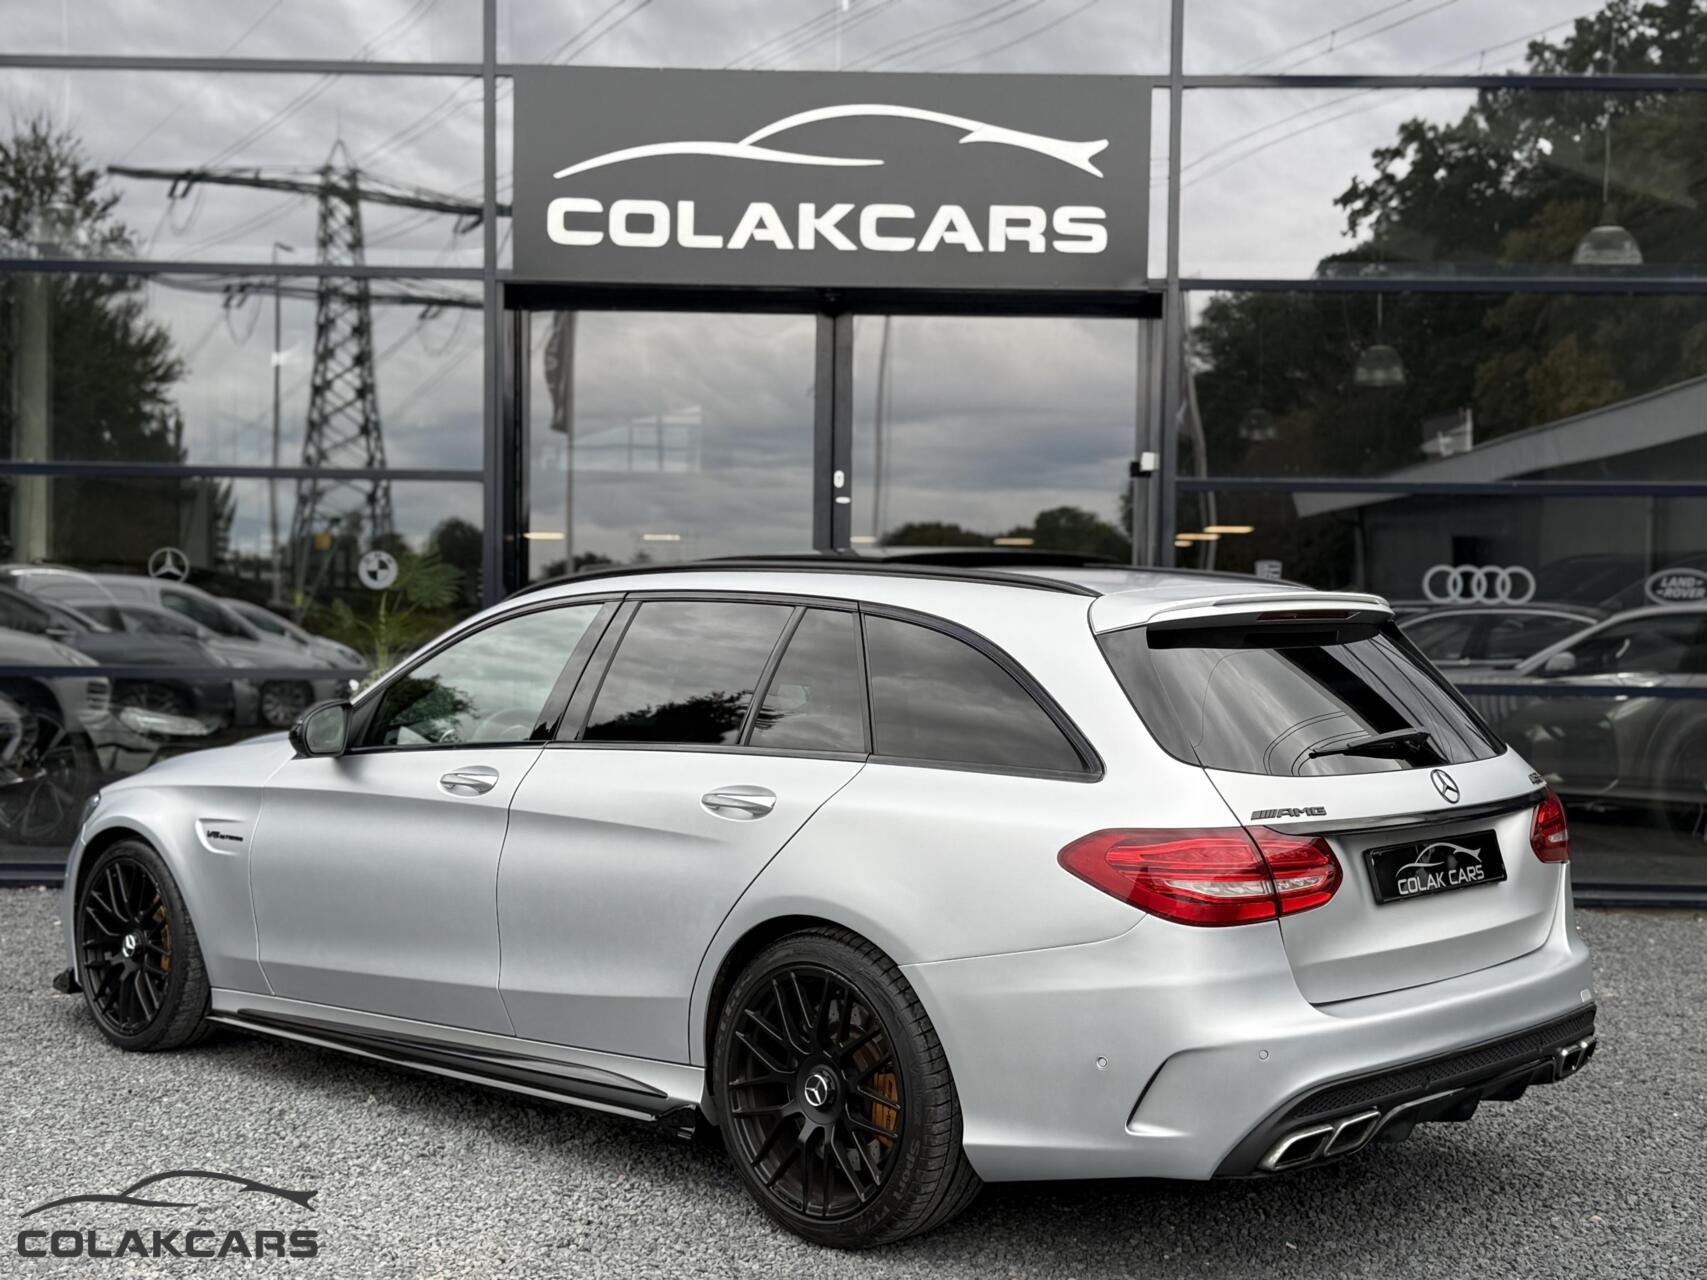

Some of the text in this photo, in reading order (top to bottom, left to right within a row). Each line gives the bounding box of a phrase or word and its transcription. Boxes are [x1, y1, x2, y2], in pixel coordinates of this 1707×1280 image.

[546, 197, 1108, 253] COLAKCARS
[1660, 576, 1695, 588] LAND
[1663, 587, 1706, 598] ROVER
[1276, 806, 1327, 819] AMG
[1397, 864, 1485, 895] COLAK CARS
